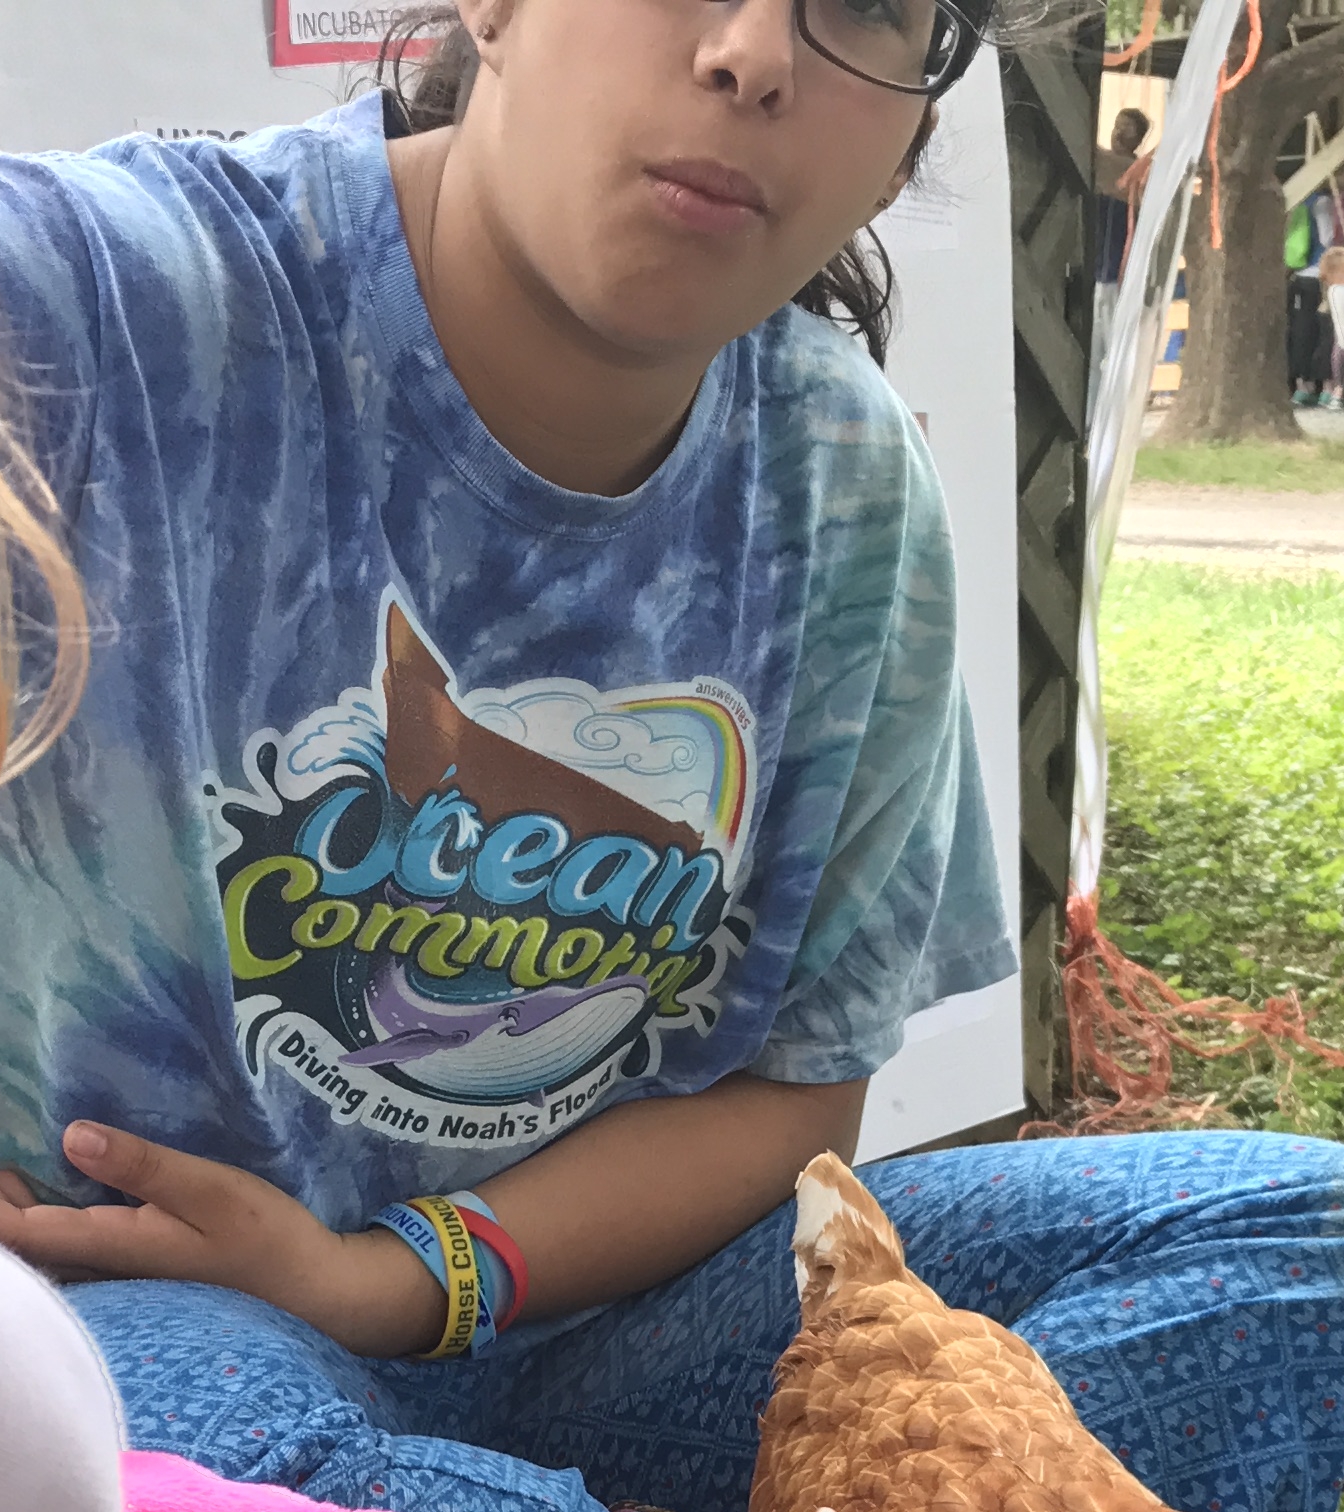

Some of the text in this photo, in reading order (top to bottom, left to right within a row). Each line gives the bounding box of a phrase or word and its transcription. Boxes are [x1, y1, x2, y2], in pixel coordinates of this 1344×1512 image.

[223, 855, 702, 1018] Commotion
[292, 785, 724, 952] Ocean
[277, 1030, 612, 1142] Diving into Noah's Flood
[446, 1278, 475, 1350] HORSE
